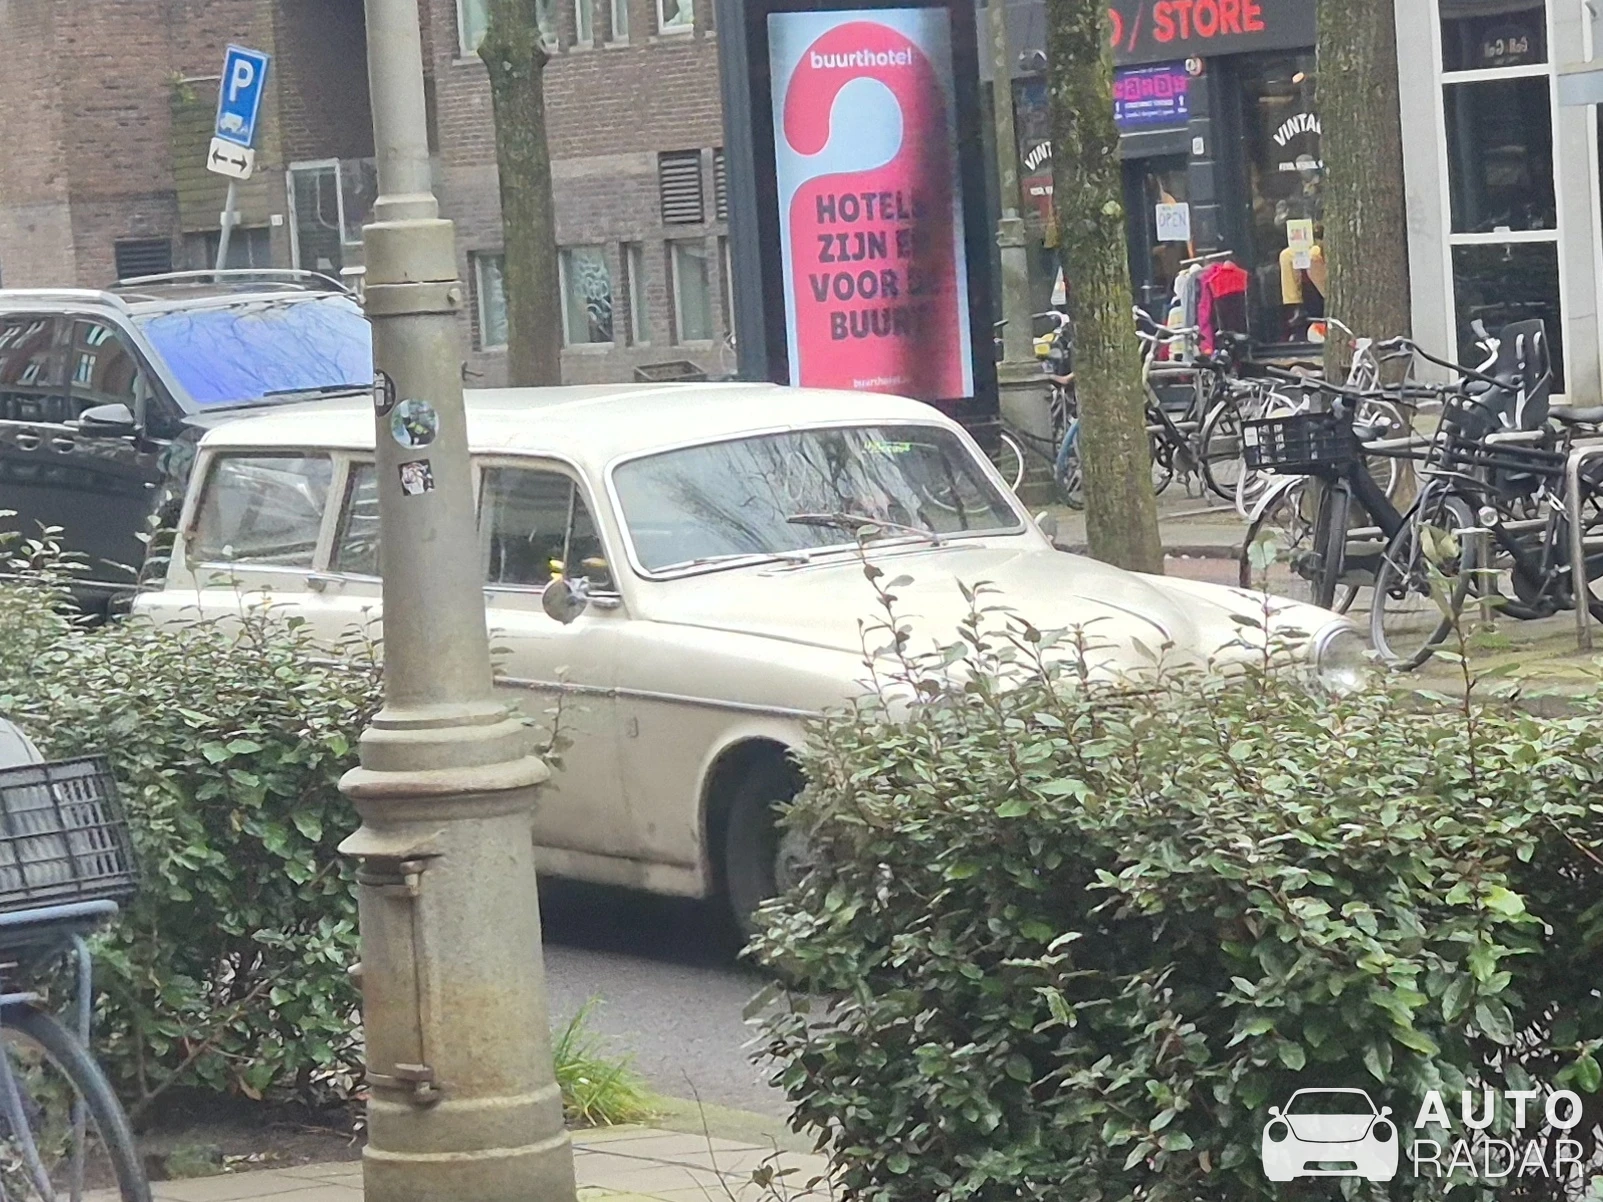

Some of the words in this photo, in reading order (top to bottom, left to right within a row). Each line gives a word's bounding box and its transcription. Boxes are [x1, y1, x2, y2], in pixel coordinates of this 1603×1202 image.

[1153, 0, 1265, 43] STORE
[811, 48, 912, 69] buurthotel
[229, 58, 254, 102] P
[817, 231, 887, 263] ZIJN
[809, 268, 899, 303] VOOR
